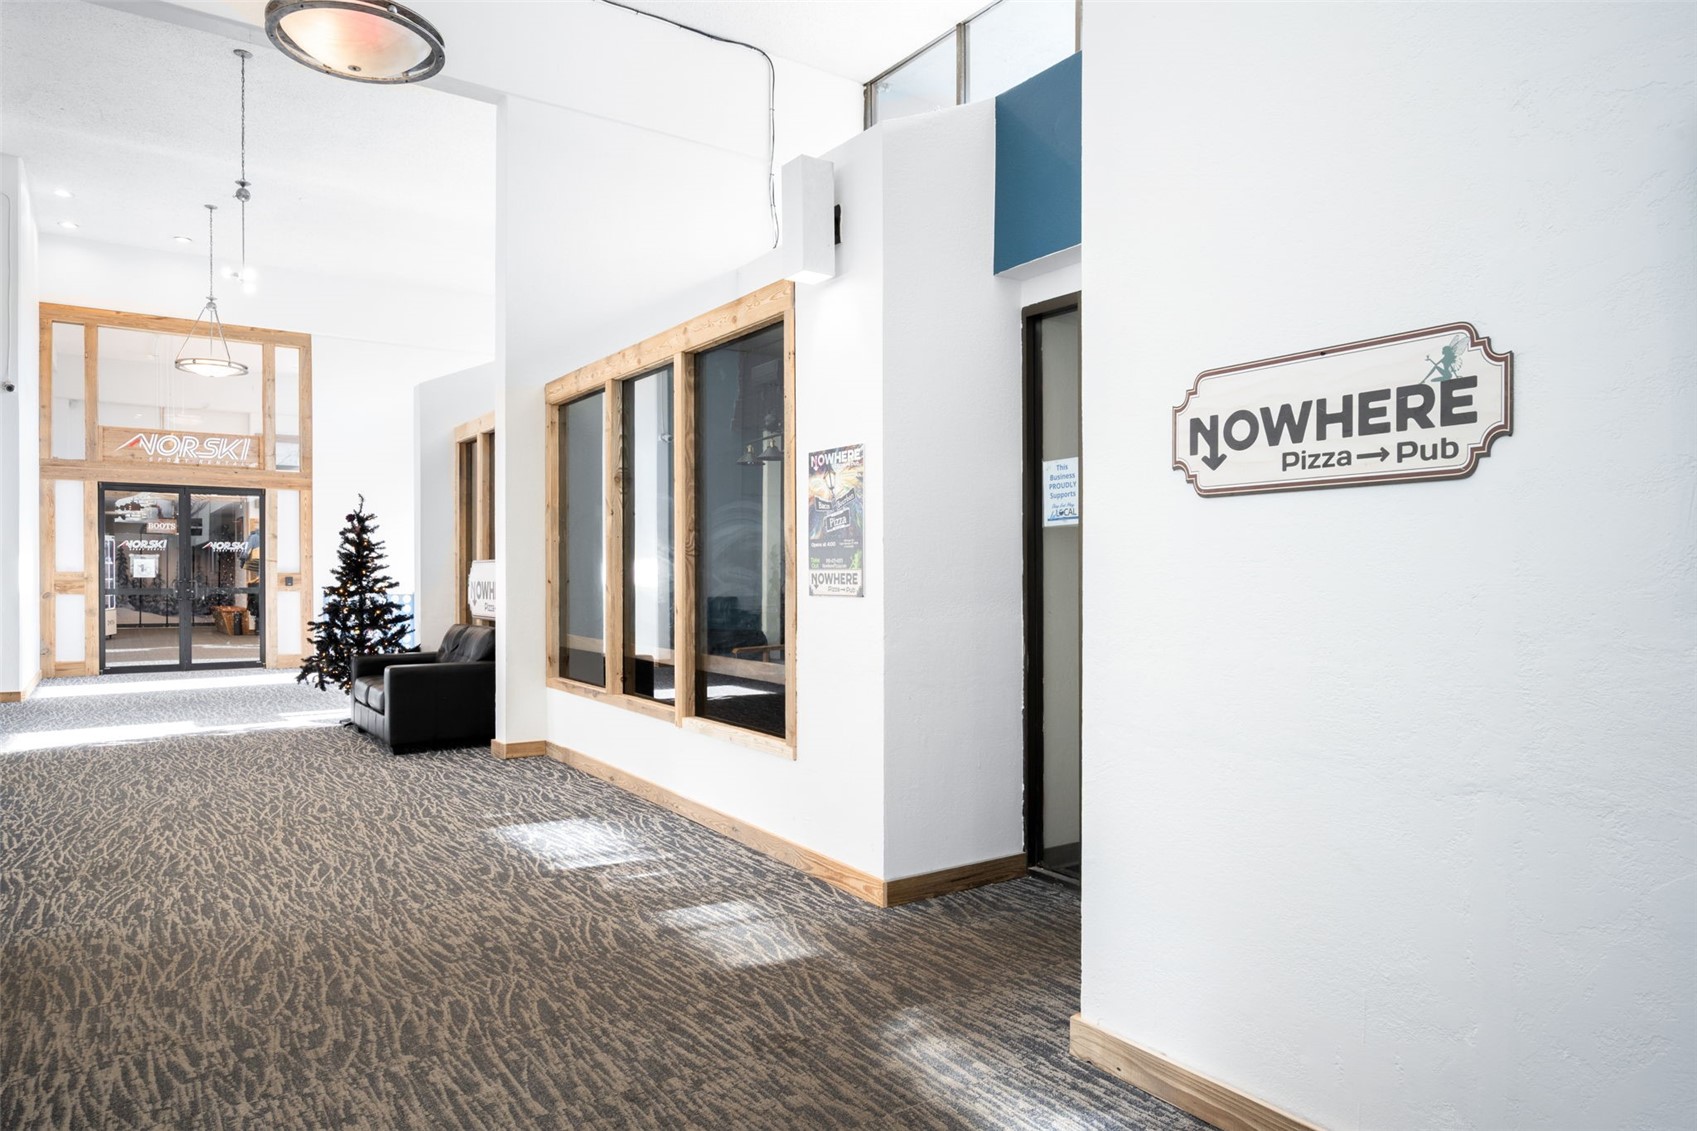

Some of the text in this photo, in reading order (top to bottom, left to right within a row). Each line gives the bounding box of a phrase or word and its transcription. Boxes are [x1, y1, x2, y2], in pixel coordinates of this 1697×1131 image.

[1190, 375, 1478, 470] NOWHERE
[114, 433, 251, 461] NORSKI
[810, 449, 862, 471] NOWHERE
[1282, 437, 1459, 471] Pizza Pub
[1050, 473, 1075, 481] Business
[1049, 481, 1077, 490] PROUDLY
[1050, 491, 1076, 499] Supports
[147, 522, 177, 530] BOOTS
[829, 516, 847, 528] Pizza
[117, 539, 168, 549] NORSKI
[202, 541, 249, 551] NORSKI
[811, 572, 859, 589] NOWHERE
[470, 581, 496, 604] NOWH
